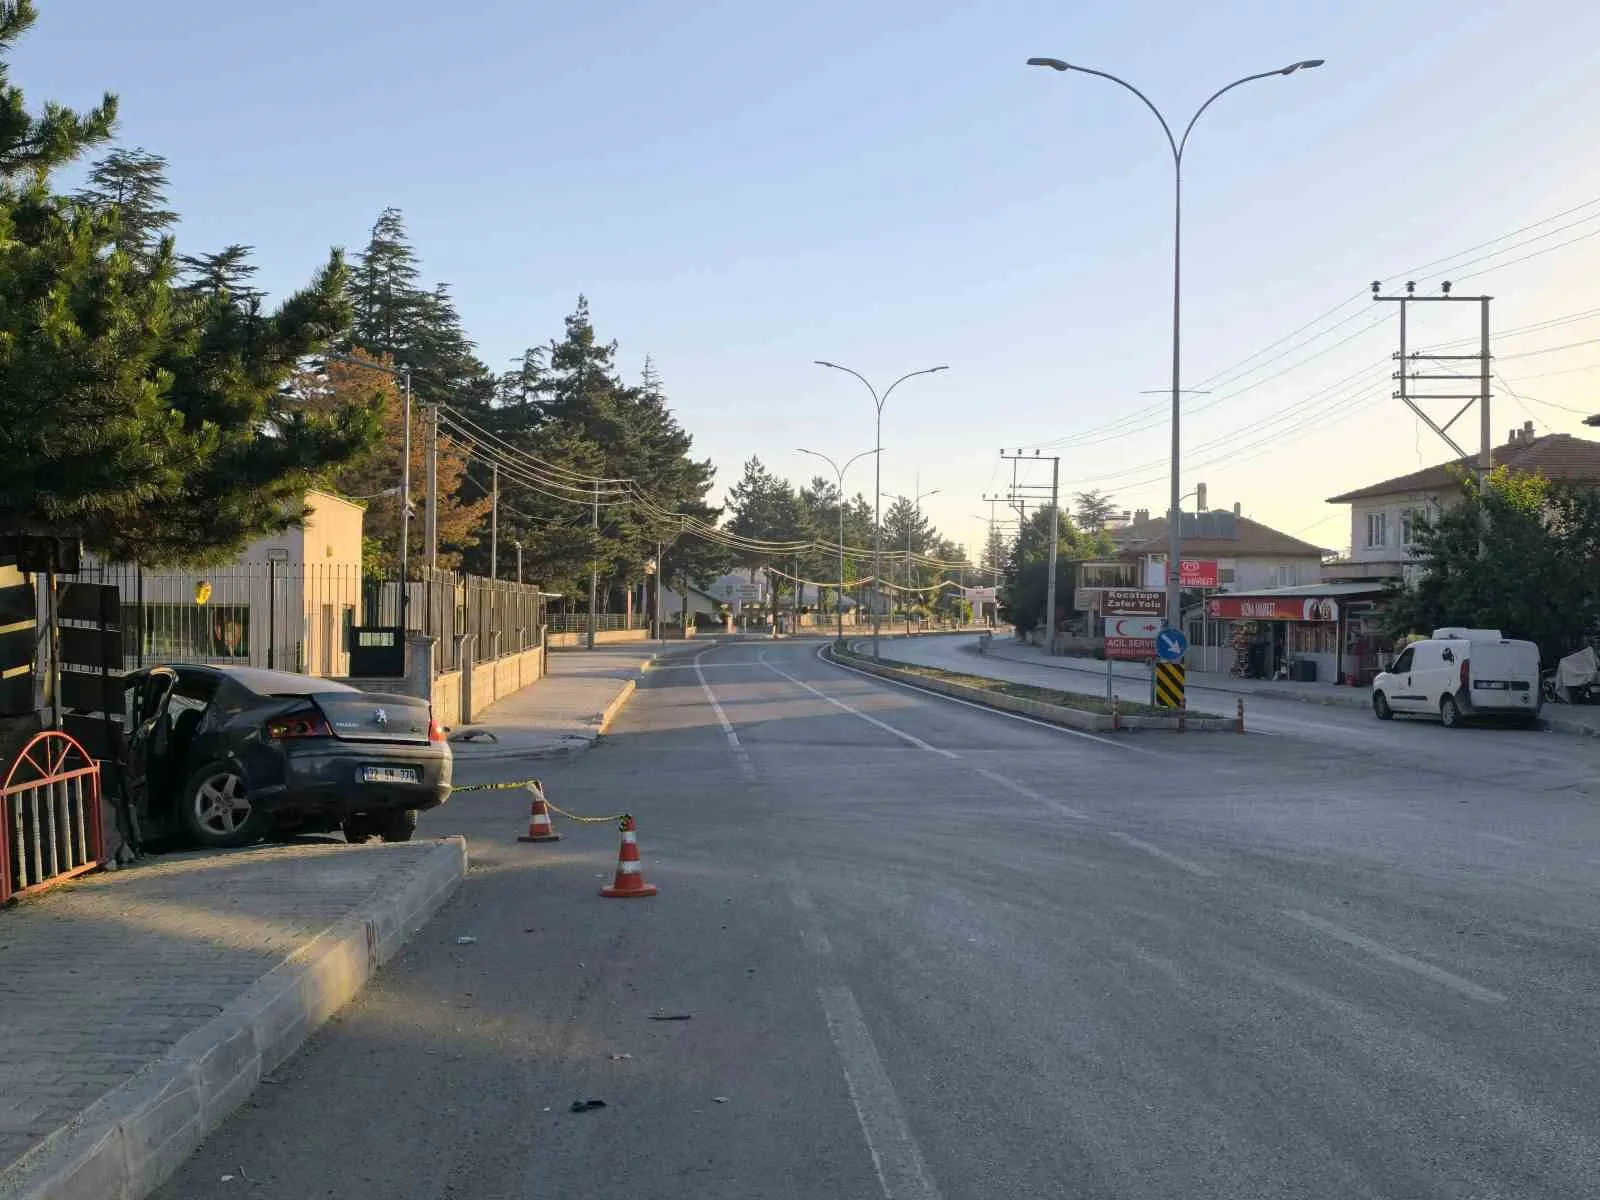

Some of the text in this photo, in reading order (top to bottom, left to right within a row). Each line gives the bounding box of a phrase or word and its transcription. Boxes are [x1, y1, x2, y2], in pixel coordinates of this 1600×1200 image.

[1108, 591, 1160, 601] Kocatepe
[1107, 599, 1160, 608] Zafer Yolu
